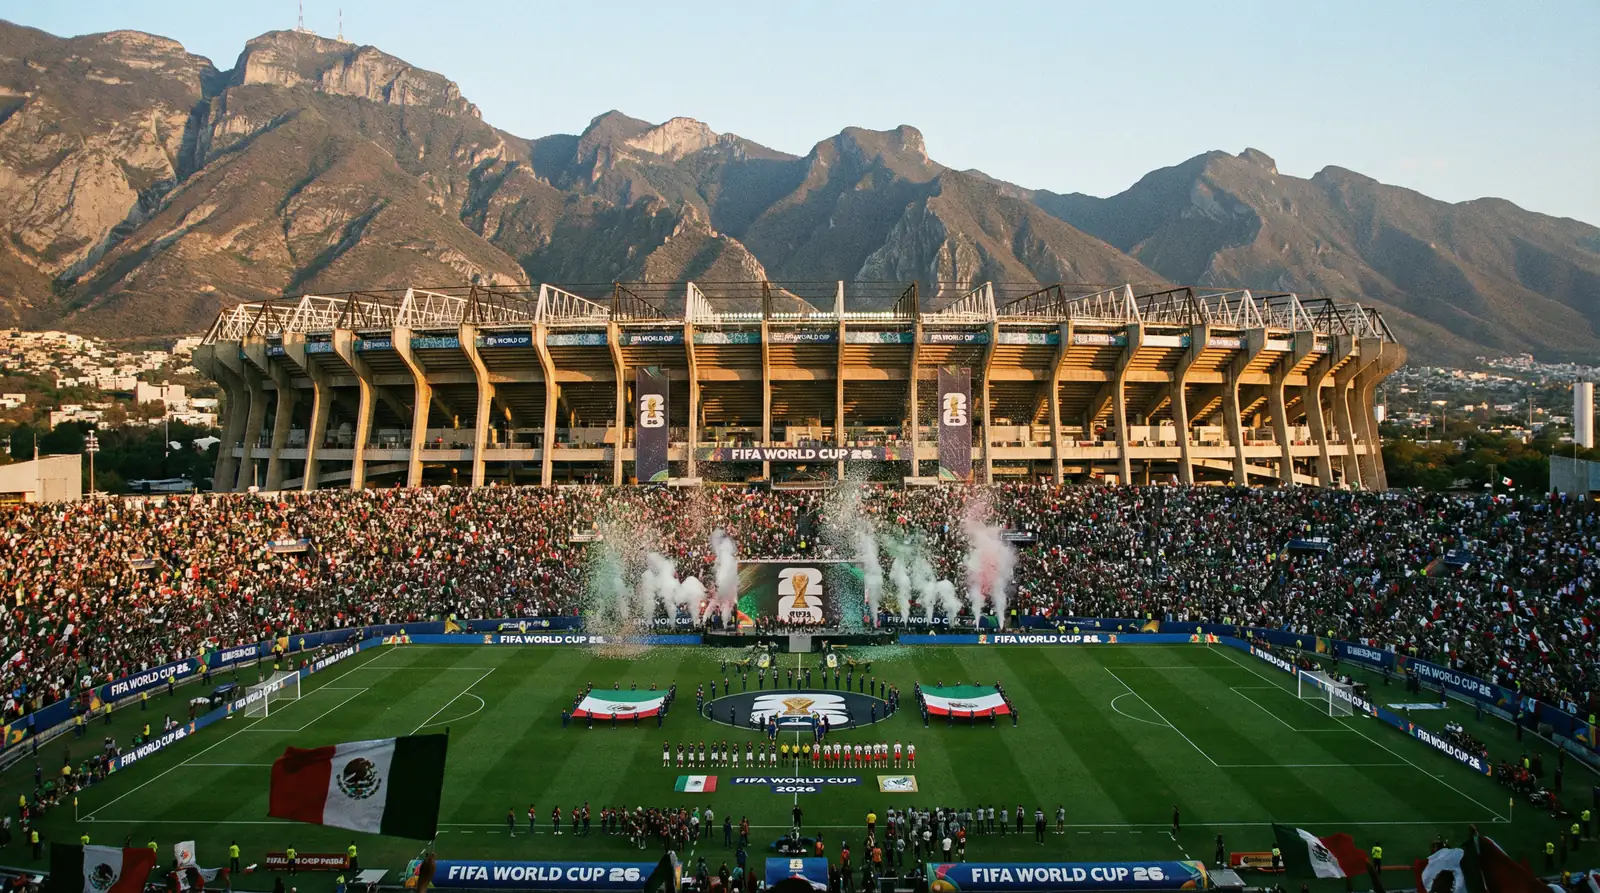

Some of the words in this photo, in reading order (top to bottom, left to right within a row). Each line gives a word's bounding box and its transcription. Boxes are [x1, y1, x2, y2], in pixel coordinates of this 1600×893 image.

[732, 449, 762, 460] FIFA
[764, 449, 816, 460] WORLD
[818, 449, 848, 460] CUP
[500, 636, 523, 644] FIFA
[524, 636, 562, 644] WORLD
[564, 636, 586, 644] CUP
[112, 682, 129, 696] FIFA
[129, 672, 158, 690] WORLD
[160, 666, 176, 679] CUP
[1414, 662, 1430, 676] FIFA
[1432, 668, 1460, 686] WORLD
[1462, 678, 1478, 692] CUP
[120, 752, 136, 766] FIFA
[136, 740, 160, 759] WORLD
[162, 732, 174, 746] CUP
[1418, 728, 1430, 744] FIFA
[1431, 736, 1454, 755] WORLD
[1454, 748, 1468, 762] CUP
[448, 866, 488, 880] FIFA
[494, 866, 562, 881] WORLD
[566, 866, 606, 882] CUP
[972, 868, 1014, 882] FIFA
[1016, 868, 1086, 882] WORLD
[1090, 867, 1128, 882] CUP
